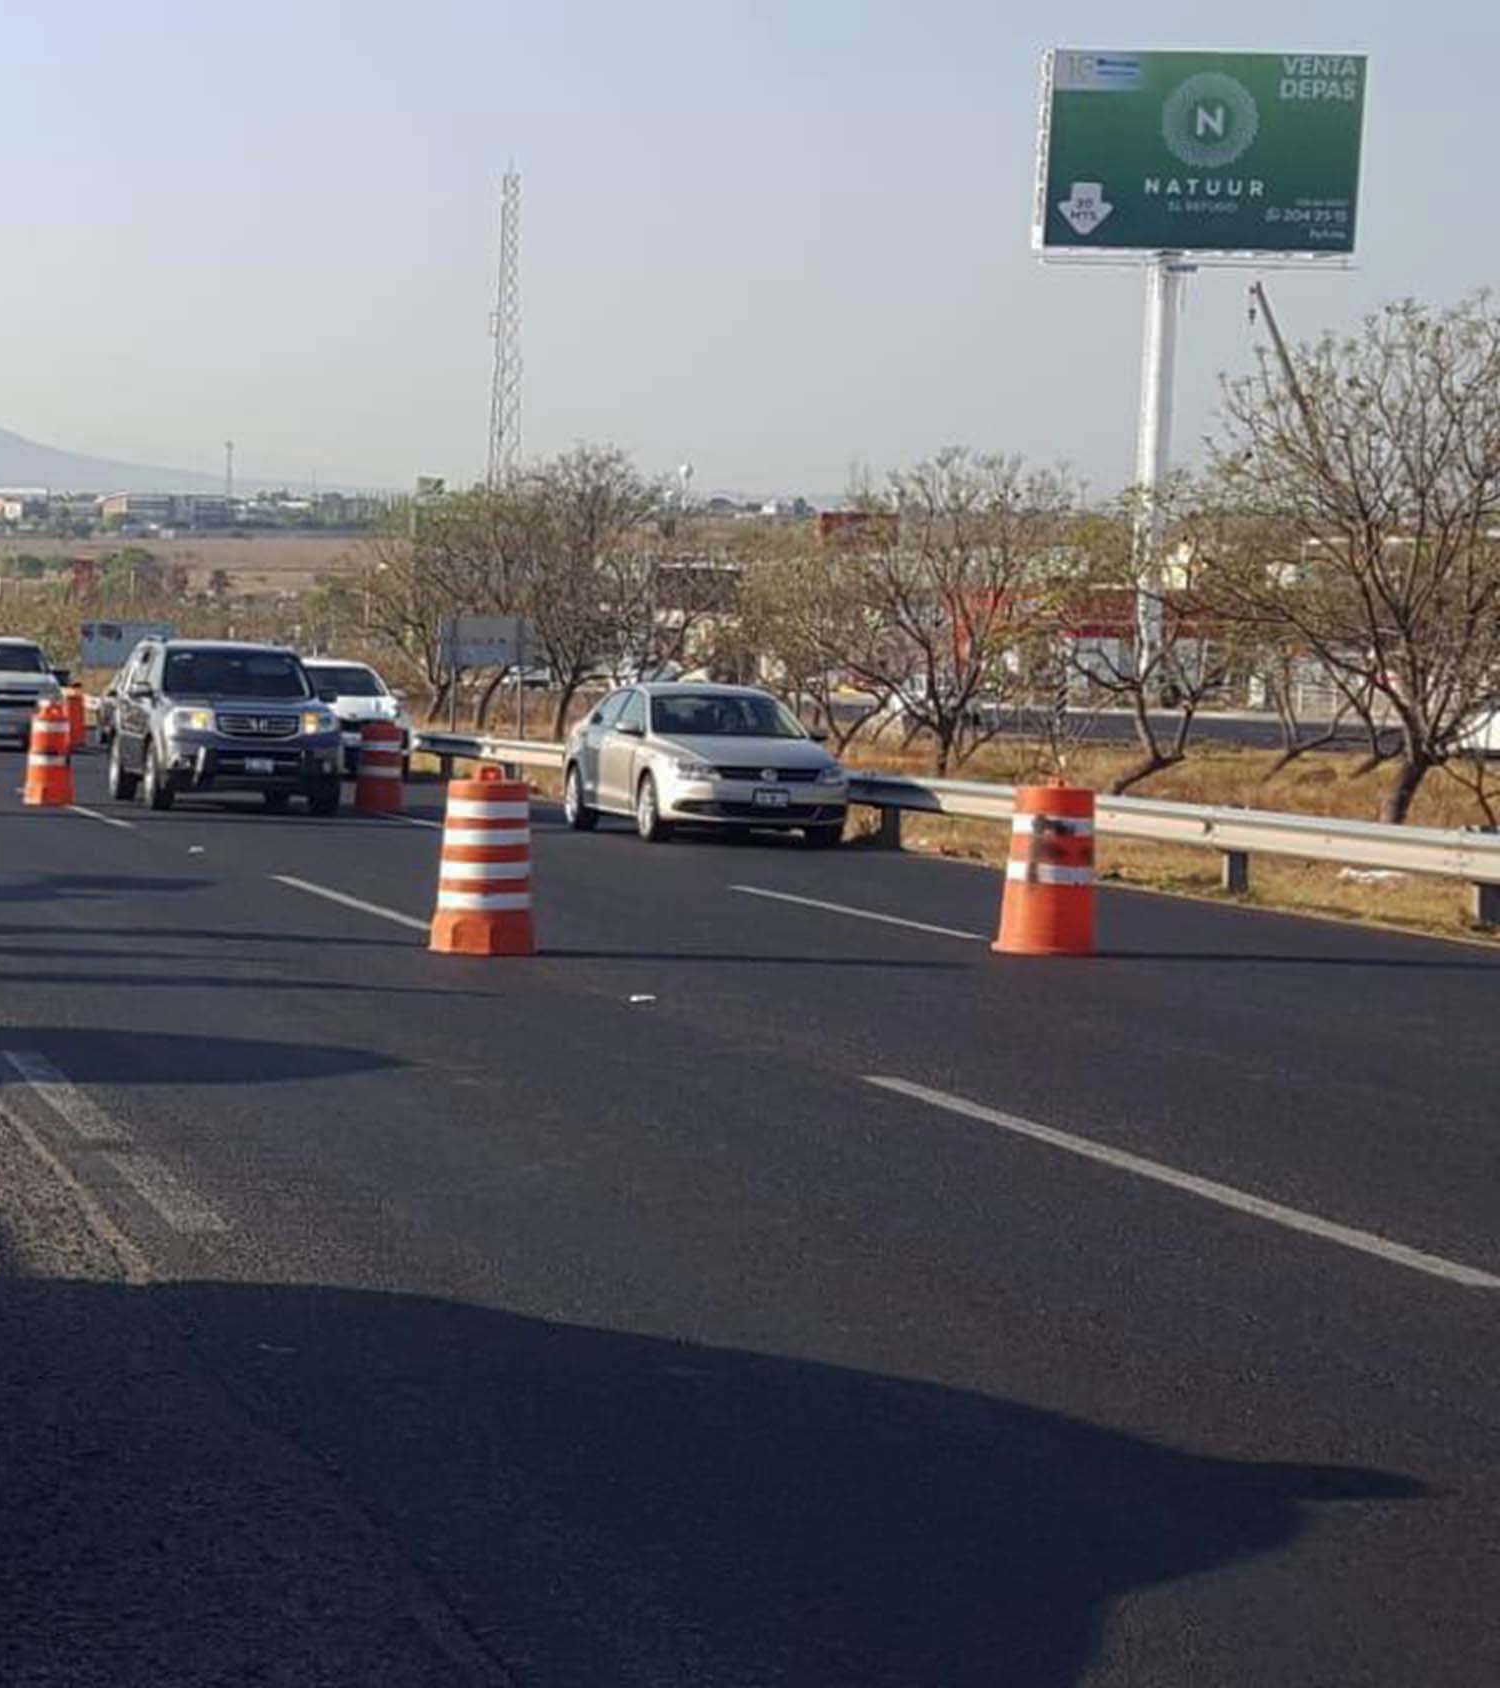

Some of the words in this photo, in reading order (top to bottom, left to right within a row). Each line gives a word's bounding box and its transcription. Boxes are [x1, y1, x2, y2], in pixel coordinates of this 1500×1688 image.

[1282, 56, 1358, 77] VENTA
[1279, 78, 1357, 100] DEPAS
[1195, 105, 1225, 137] N
[1143, 178, 1266, 198] NATUUR
